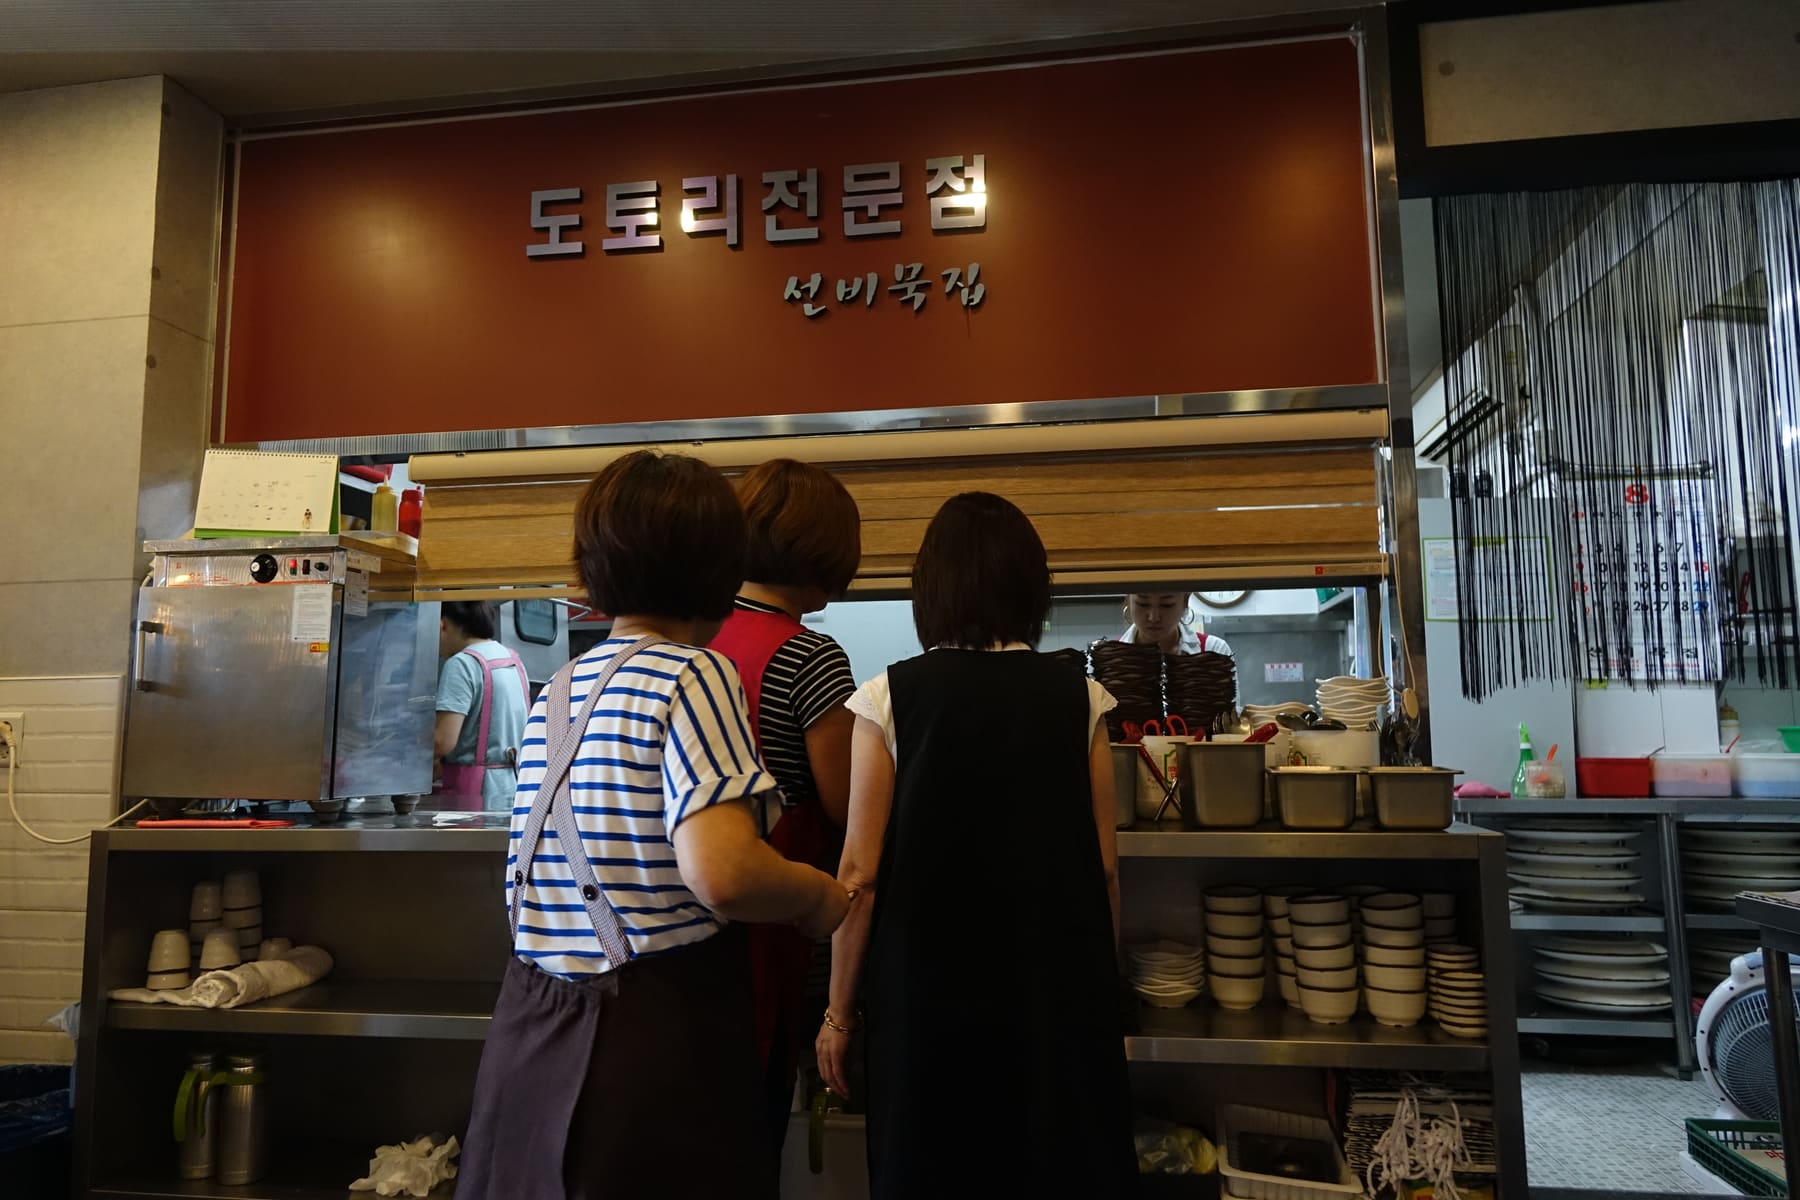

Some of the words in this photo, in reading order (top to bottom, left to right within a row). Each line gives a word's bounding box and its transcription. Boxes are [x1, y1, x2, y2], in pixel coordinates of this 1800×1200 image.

[525, 153, 987, 257] 도토리전문점
[783, 261, 986, 317] 선비묵집
[1625, 484, 1649, 504] 8
[1633, 562, 1649, 573] 12
[1633, 581, 1649, 592] 19
